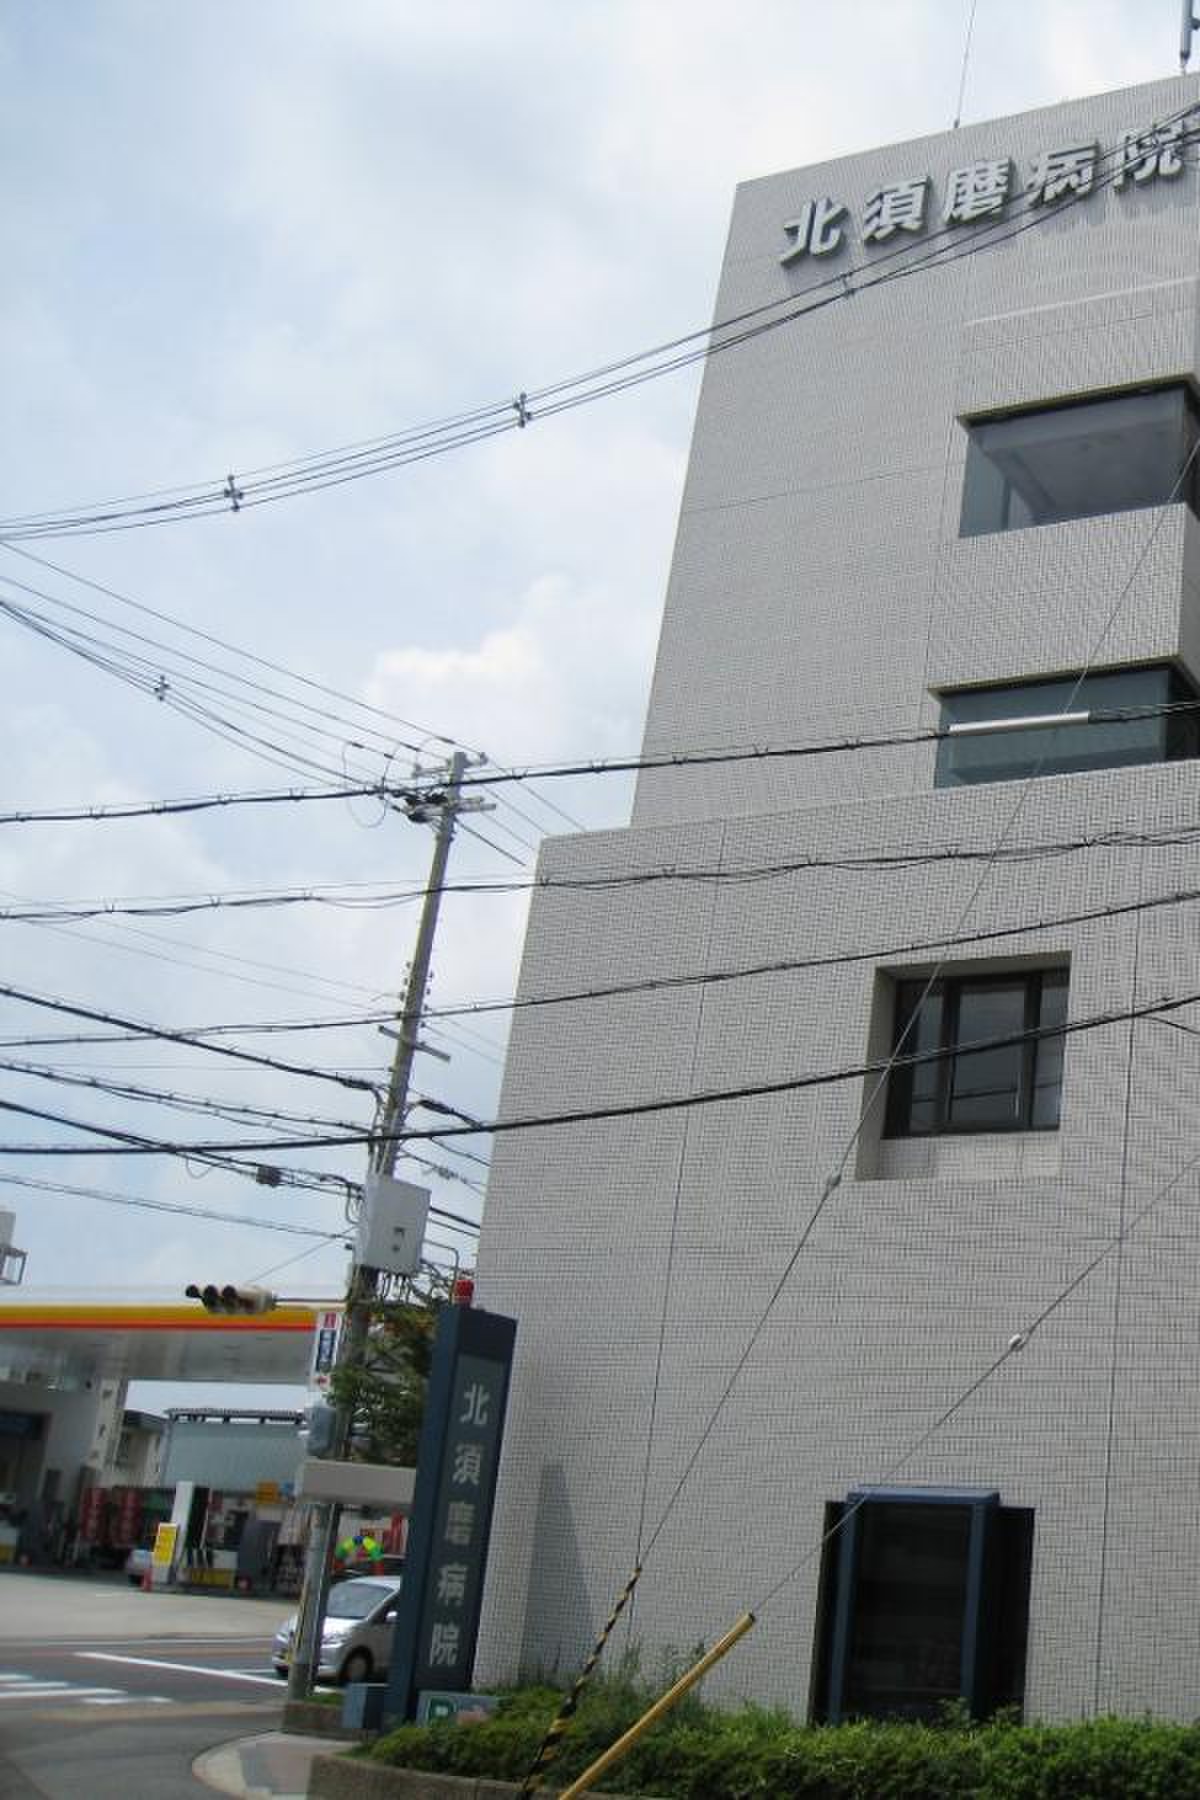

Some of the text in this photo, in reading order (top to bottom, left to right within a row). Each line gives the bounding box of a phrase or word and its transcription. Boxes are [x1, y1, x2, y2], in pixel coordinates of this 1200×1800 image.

[780, 119, 1187, 267] 北須磨病院
[428, 1382, 490, 1667] 北須磨病院
